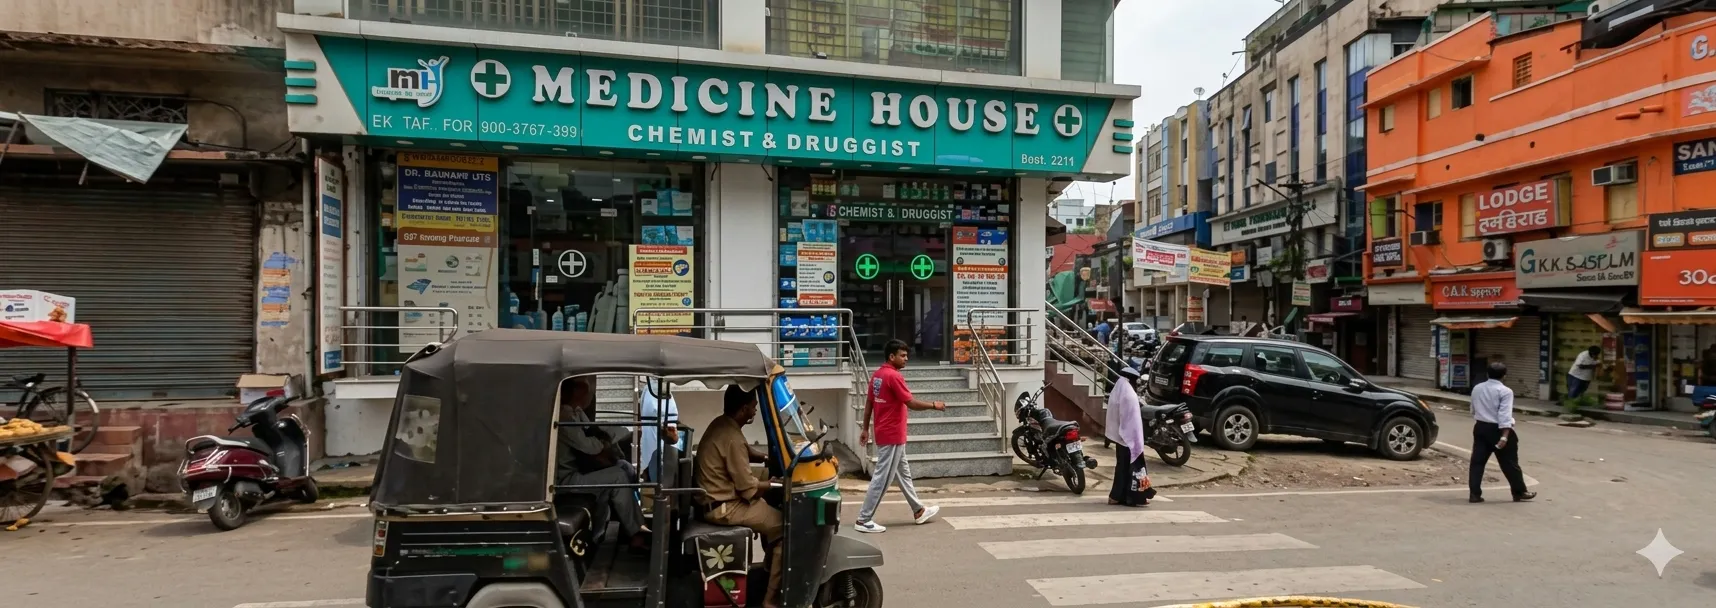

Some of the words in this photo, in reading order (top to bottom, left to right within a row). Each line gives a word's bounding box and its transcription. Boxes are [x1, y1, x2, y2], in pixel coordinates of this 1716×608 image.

[531, 64, 837, 122] MEDICINE
[870, 91, 1040, 135] HOUSE
[372, 114, 393, 129] EK
[443, 118, 473, 133] FOR
[628, 124, 753, 148] CHEMIST
[762, 132, 776, 149] &
[787, 133, 921, 157] DRUGGIST
[1051, 155, 1074, 167] 2211
[1479, 182, 1549, 210] LODGE
[838, 206, 884, 218] CHEMIST
[901, 208, 953, 220] DRUGGIST
